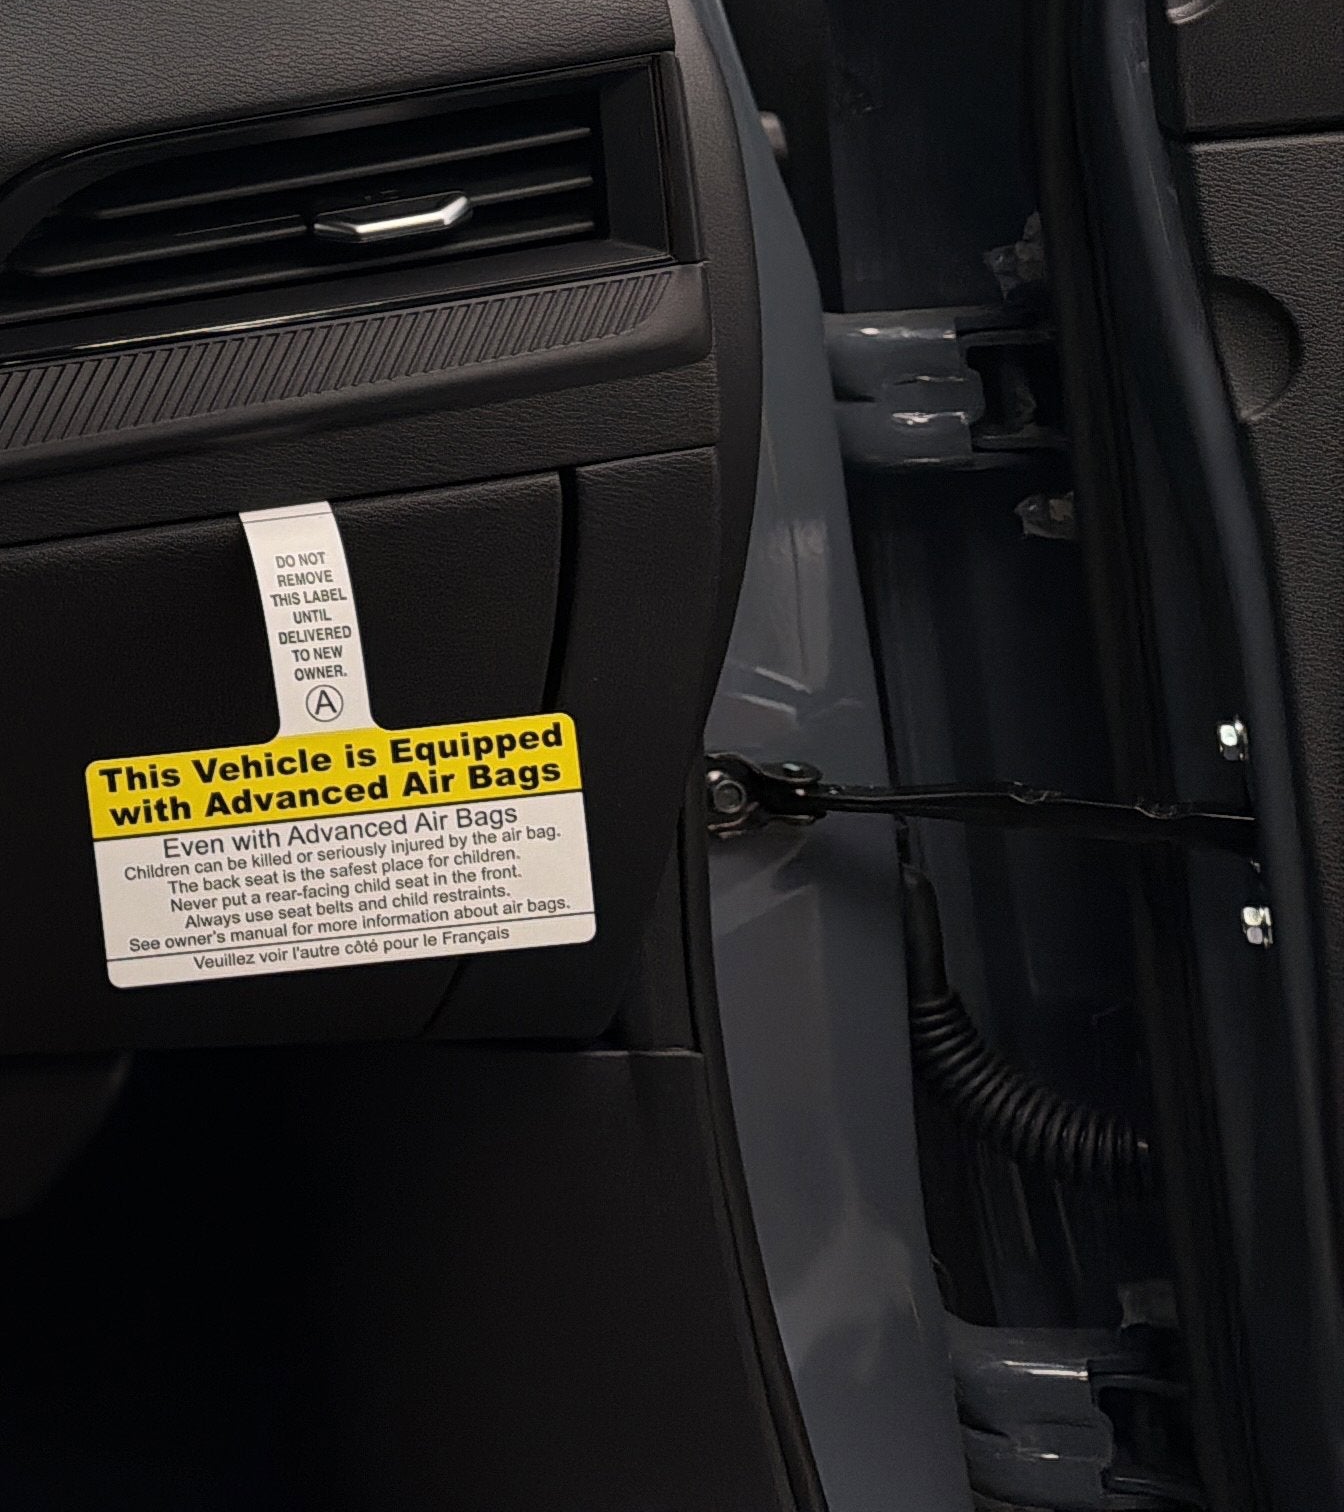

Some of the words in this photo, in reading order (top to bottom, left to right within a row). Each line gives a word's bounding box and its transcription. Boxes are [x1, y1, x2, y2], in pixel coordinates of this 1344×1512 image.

[274, 553, 296, 569] DO
[298, 551, 326, 566] NOT
[276, 569, 333, 588] REMOVE
[269, 591, 301, 607] THIS
[302, 587, 347, 604] LABEL
[292, 608, 332, 624] UNTIL
[277, 624, 352, 645] DELIVERED
[291, 648, 310, 662] TO
[313, 644, 343, 660] NEW
[294, 664, 347, 681] OWNER.
[98, 763, 181, 793] This
[191, 748, 331, 784] Vehicle
[344, 743, 377, 769] is
[389, 721, 563, 766] Equipped
[109, 795, 191, 826] with
[205, 774, 389, 817] Advanced
[402, 768, 455, 797] Air
[467, 762, 561, 791] Bags
[123, 863, 190, 881] Children
[193, 860, 223, 874] can
[226, 855, 247, 871] be
[250, 849, 292, 868] killed
[295, 850, 313, 864] or
[316, 841, 386, 861] seriously
[390, 834, 444, 856] injured
[447, 833, 468, 850] by
[471, 830, 497, 845] the
[501, 829, 522, 842] air
[525, 825, 560, 841] bag.
[162, 836, 225, 859] Even
[230, 827, 281, 852] with
[286, 813, 408, 846] Advanced
[413, 810, 448, 833] Air
[455, 806, 518, 830] Bags
[166, 879, 199, 894] The
[201, 873, 241, 891] back
[243, 870, 279, 887] seat
[281, 868, 296, 883] is
[299, 866, 325, 882] the
[328, 860, 377, 879] safest
[380, 857, 424, 876] place
[427, 853, 450, 868] for
[452, 848, 520, 866] children.
[169, 896, 218, 913] Never
[220, 891, 248, 911] put
[250, 892, 261, 905] a
[264, 882, 350, 903] rear-facing
[353, 876, 391, 894] child
[394, 873, 430, 890] seat
[432, 871, 447, 886] in
[451, 869, 477, 884] the
[480, 863, 522, 881] front.
[128, 937, 161, 953] See
[163, 929, 226, 949] owner's
[229, 922, 288, 942] manual
[291, 920, 313, 936] for
[316, 918, 357, 933] more
[361, 908, 449, 929] information
[453, 902, 499, 920] about
[501, 899, 523, 915] air
[526, 897, 570, 914] bags.
[183, 912, 241, 929] Always
[244, 909, 274, 923] use
[277, 902, 313, 920] seat
[314, 899, 354, 916] belts
[357, 894, 388, 912] and
[391, 890, 429, 908] child
[432, 884, 510, 904] restraints.
[192, 952, 256, 970] Veuillez
[257, 947, 289, 963] voir
[291, 943, 340, 960] l'autre
[343, 937, 378, 955] côté
[382, 936, 419, 954] pour
[422, 933, 437, 947] le
[441, 927, 510, 945] Français
